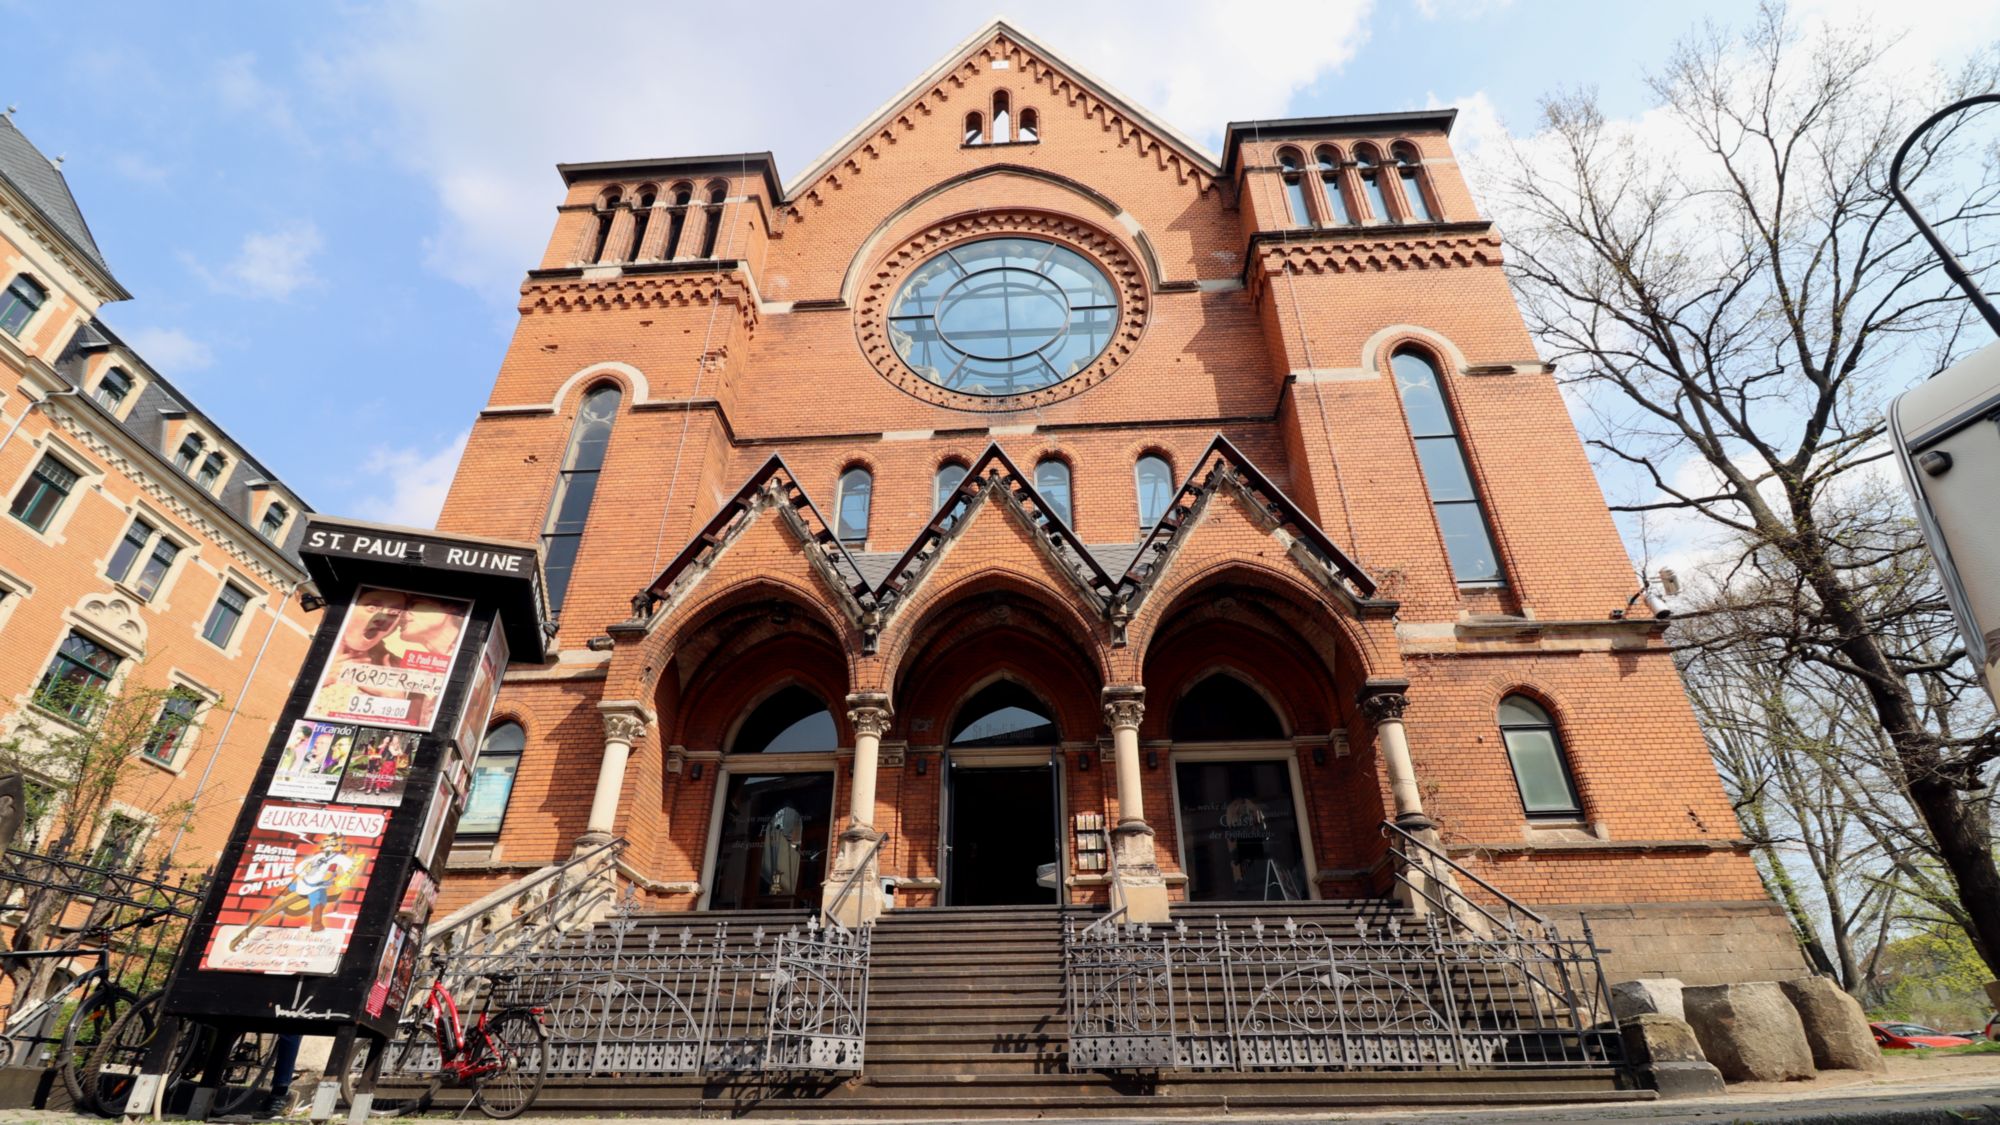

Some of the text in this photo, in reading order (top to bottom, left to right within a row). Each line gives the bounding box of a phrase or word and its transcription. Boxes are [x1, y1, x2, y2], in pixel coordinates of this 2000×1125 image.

[308, 531, 345, 550] ST.
[446, 548, 523, 573] RUINE
[349, 695, 406, 717] 9.5. 19:00
[271, 809, 381, 834] UKRAINIENS
[243, 862, 296, 881] LIVE
[238, 881, 264, 896] ON
